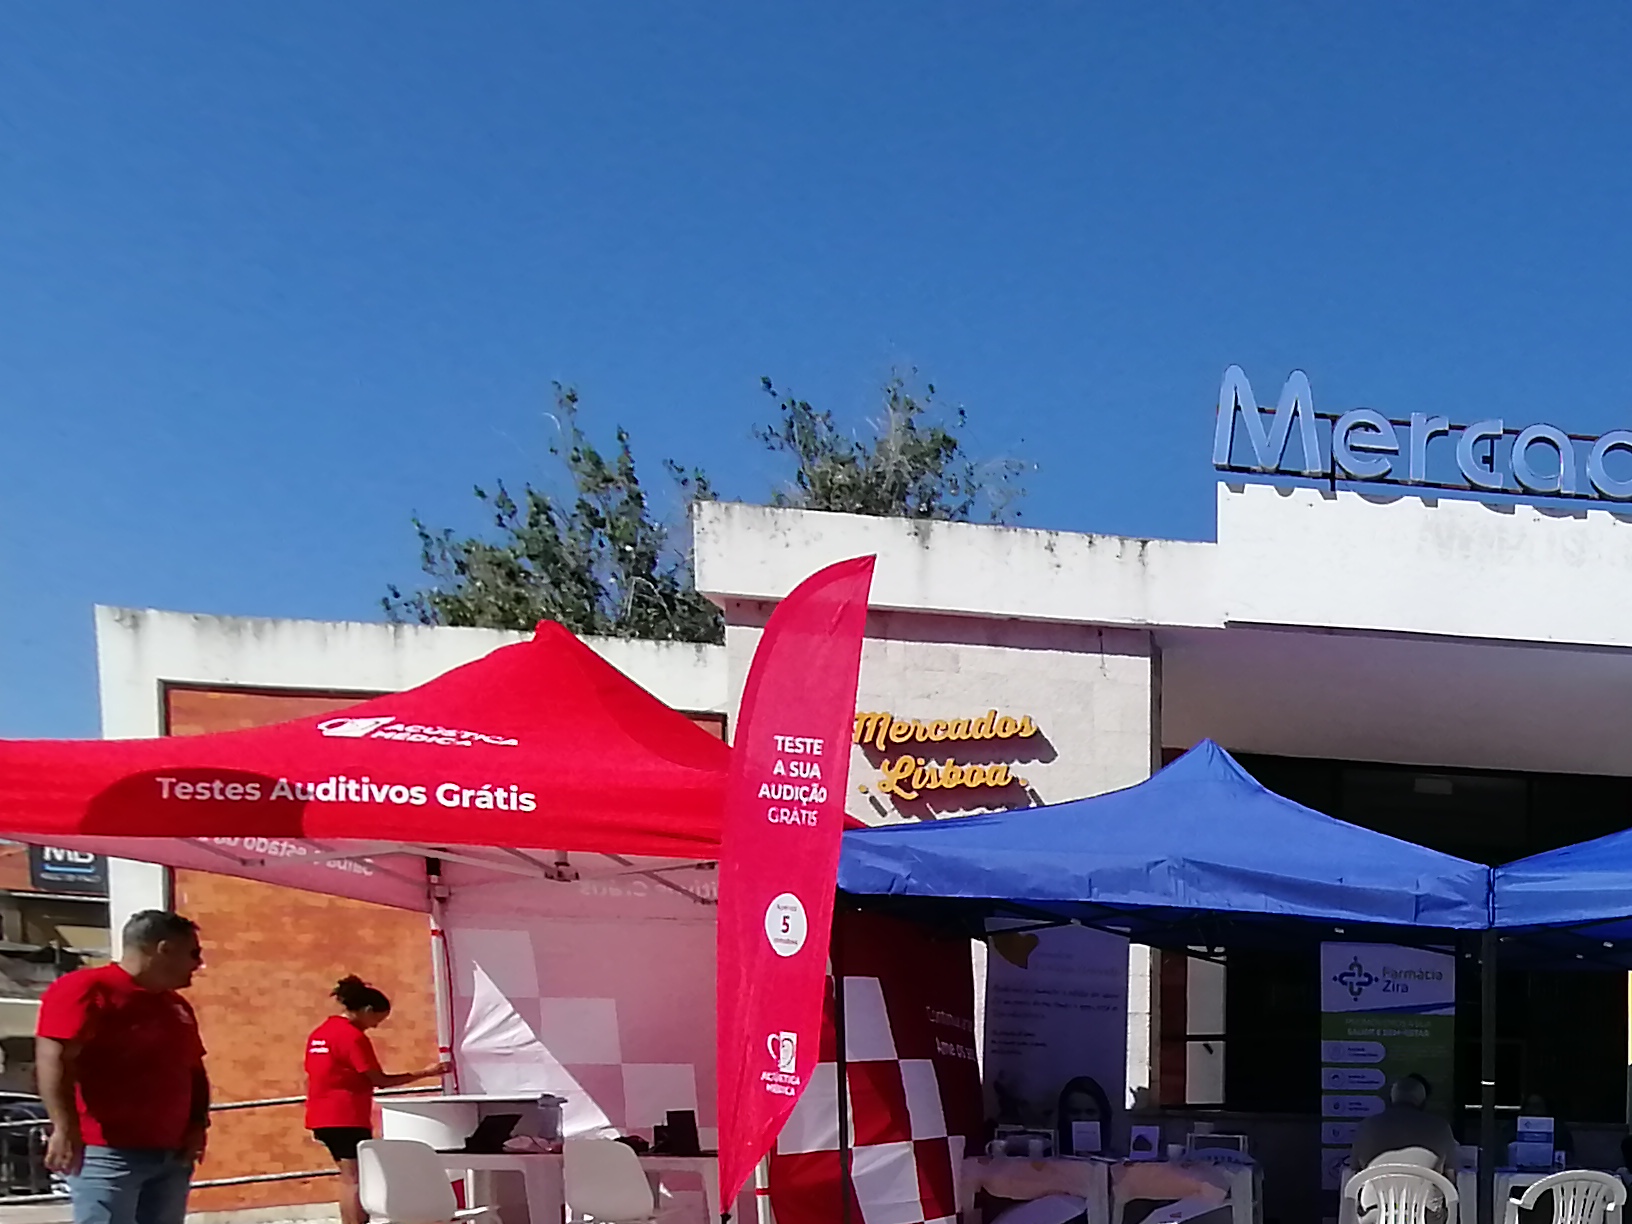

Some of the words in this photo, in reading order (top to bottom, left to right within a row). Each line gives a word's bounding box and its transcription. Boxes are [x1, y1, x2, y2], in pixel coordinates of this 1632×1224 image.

[853, 709, 1038, 751] Mercados
[773, 734, 824, 756] TESTE
[772, 759, 786, 776] A
[789, 760, 822, 780] SUA
[877, 754, 1015, 800] Lisboa
[155, 775, 262, 801] Testes
[269, 775, 428, 806] Auditivos
[435, 781, 538, 813] Grátis
[758, 782, 828, 807] AUDIÇÃO
[767, 806, 818, 827] GRÁTIS
[781, 914, 791, 934] 5
[1382, 980, 1409, 993] Zira
